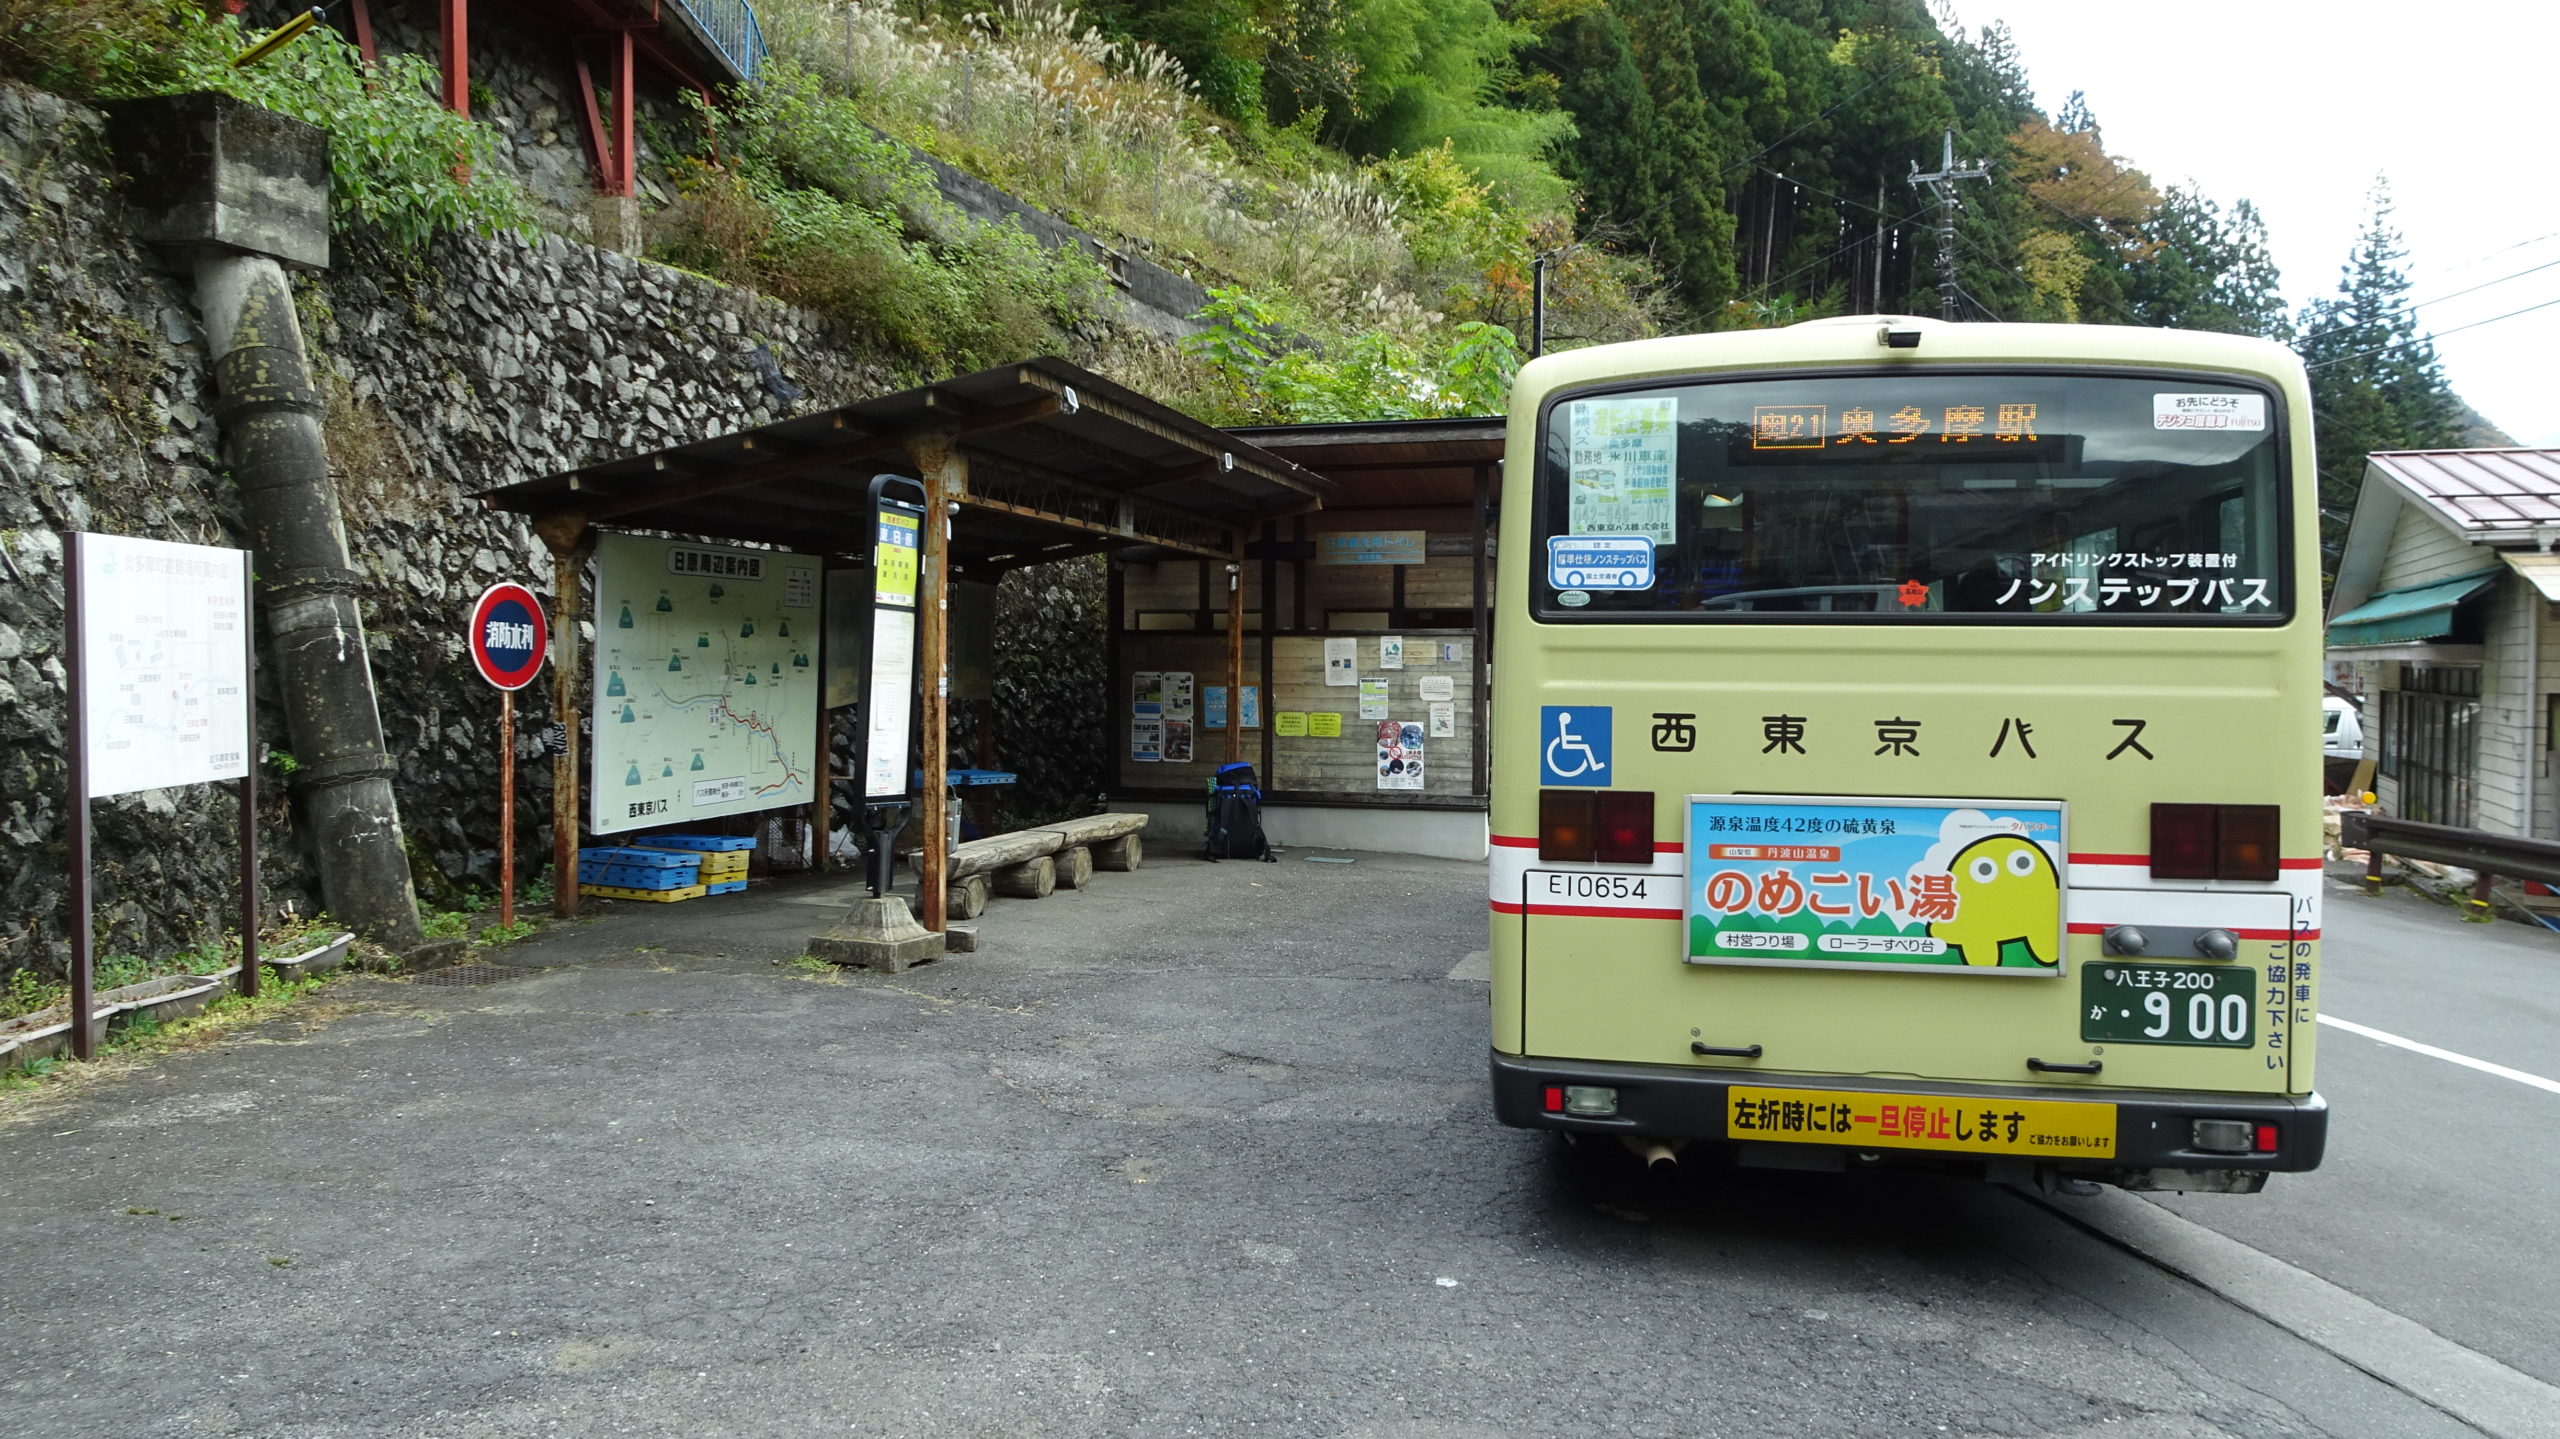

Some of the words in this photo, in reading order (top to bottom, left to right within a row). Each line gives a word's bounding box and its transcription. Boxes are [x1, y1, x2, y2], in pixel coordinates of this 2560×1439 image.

[2176, 397, 2239, 408] お先にどうぞ
[1759, 413, 1819, 440] 奥21
[1836, 403, 2038, 443] 奥多摩駅
[1574, 450, 1602, 464] 勤務地
[1608, 450, 1667, 463] 氷川車庫
[1587, 522, 1669, 532] 西東京バス株式会社
[675, 550, 760, 577] 日原周辺案内図
[1557, 554, 1647, 566] 標準仕様ノンステップバス
[2030, 553, 2238, 568] アイドリングストップ装置付
[1995, 577, 2272, 607] ノンステップバス
[486, 621, 534, 650] 消防水利
[1651, 712, 2154, 761] 西東京バス
[628, 799, 668, 818] 西東京バス
[1709, 815, 1896, 835] 源泉温度42度の硫黄泉
[1729, 848, 1752, 856] 山梨県
[1767, 848, 1830, 859] 丹波山温泉
[1549, 875, 1647, 899] E10654
[1706, 869, 1959, 921] のめこい湯
[1726, 934, 1795, 948] 村営つり場
[1830, 937, 1934, 952] ローラーすべり台
[2294, 896, 2314, 1024] バスの発車に
[2090, 1004, 2108, 1021] か
[2266, 942, 2288, 1070] ご協力下さい
[1734, 1098, 2026, 1144] 左折時には一旦停止します
[2029, 1134, 2110, 1148] ご協力をお願いします
